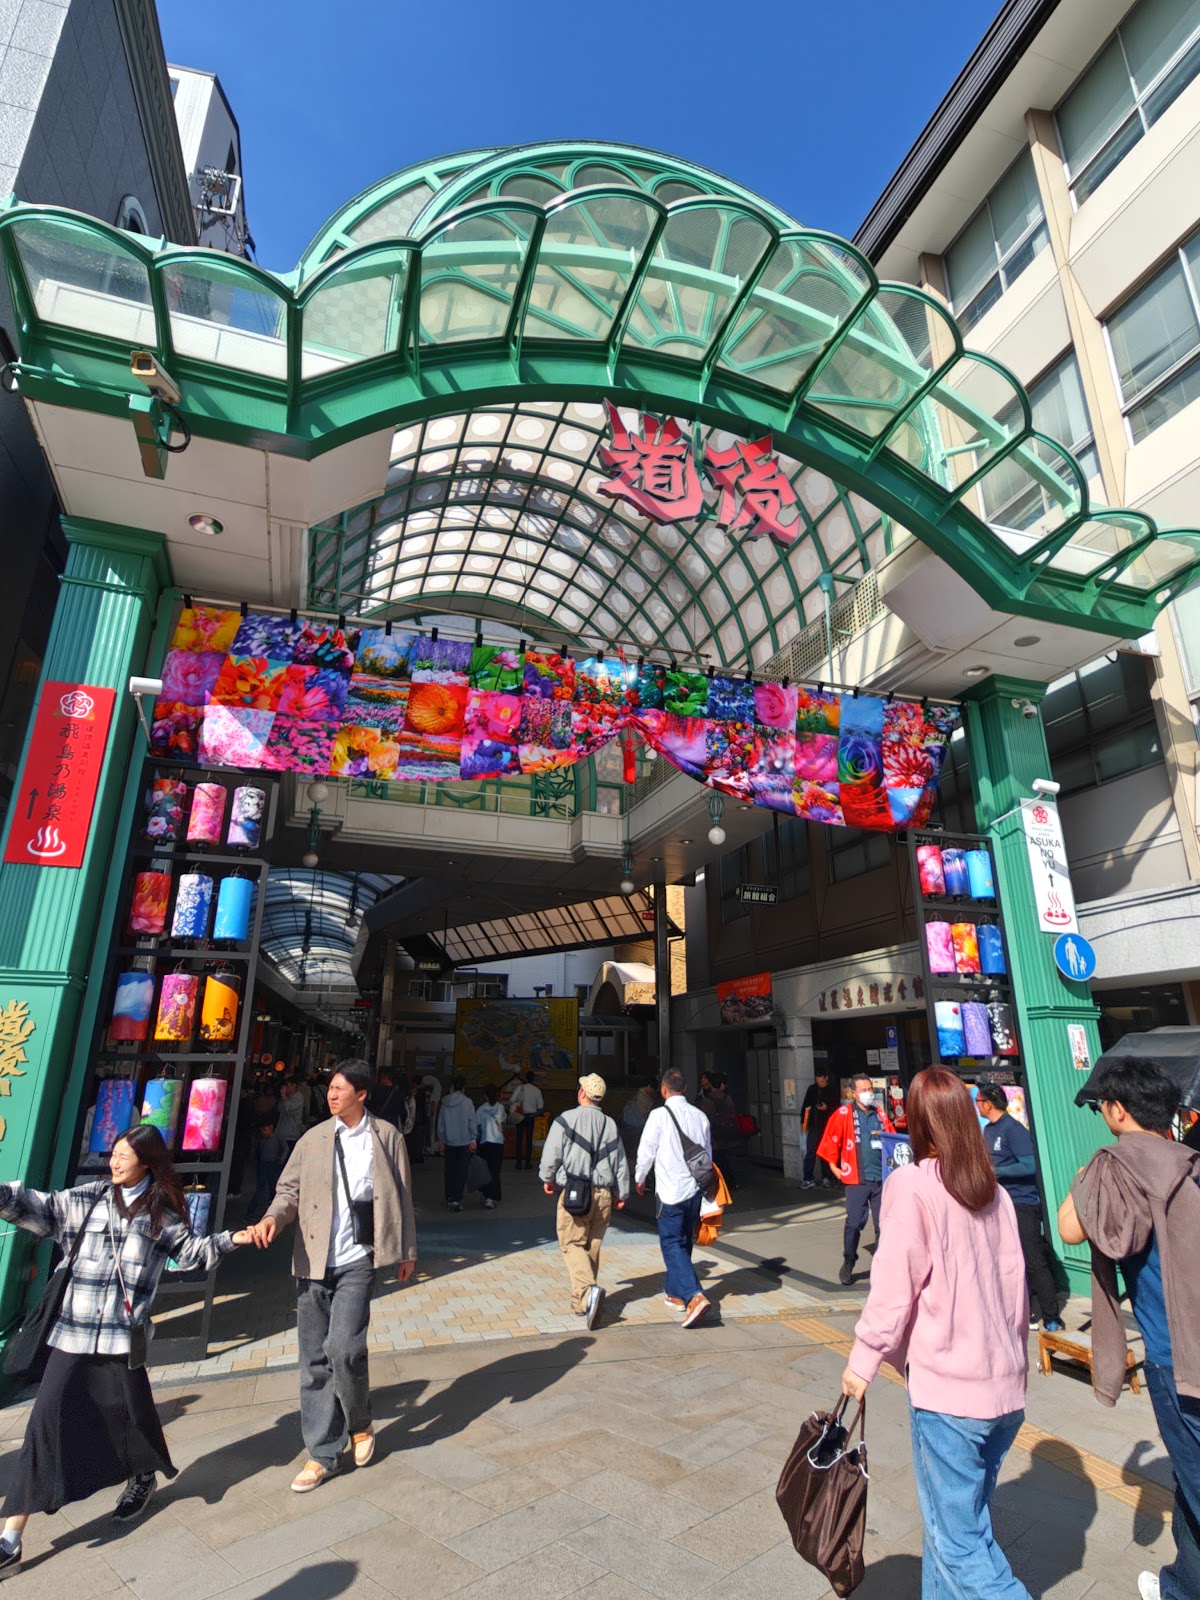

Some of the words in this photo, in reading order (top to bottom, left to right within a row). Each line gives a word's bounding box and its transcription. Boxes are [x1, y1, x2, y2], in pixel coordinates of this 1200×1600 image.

[597, 397, 801, 548] 道後
[41, 723, 80, 822] 飛鳥乃湯泉
[1030, 837, 1061, 848] ASUKA
[1040, 848, 1054, 858] NO
[1042, 860, 1055, 869] YU
[743, 891, 777, 902] 旅館組合
